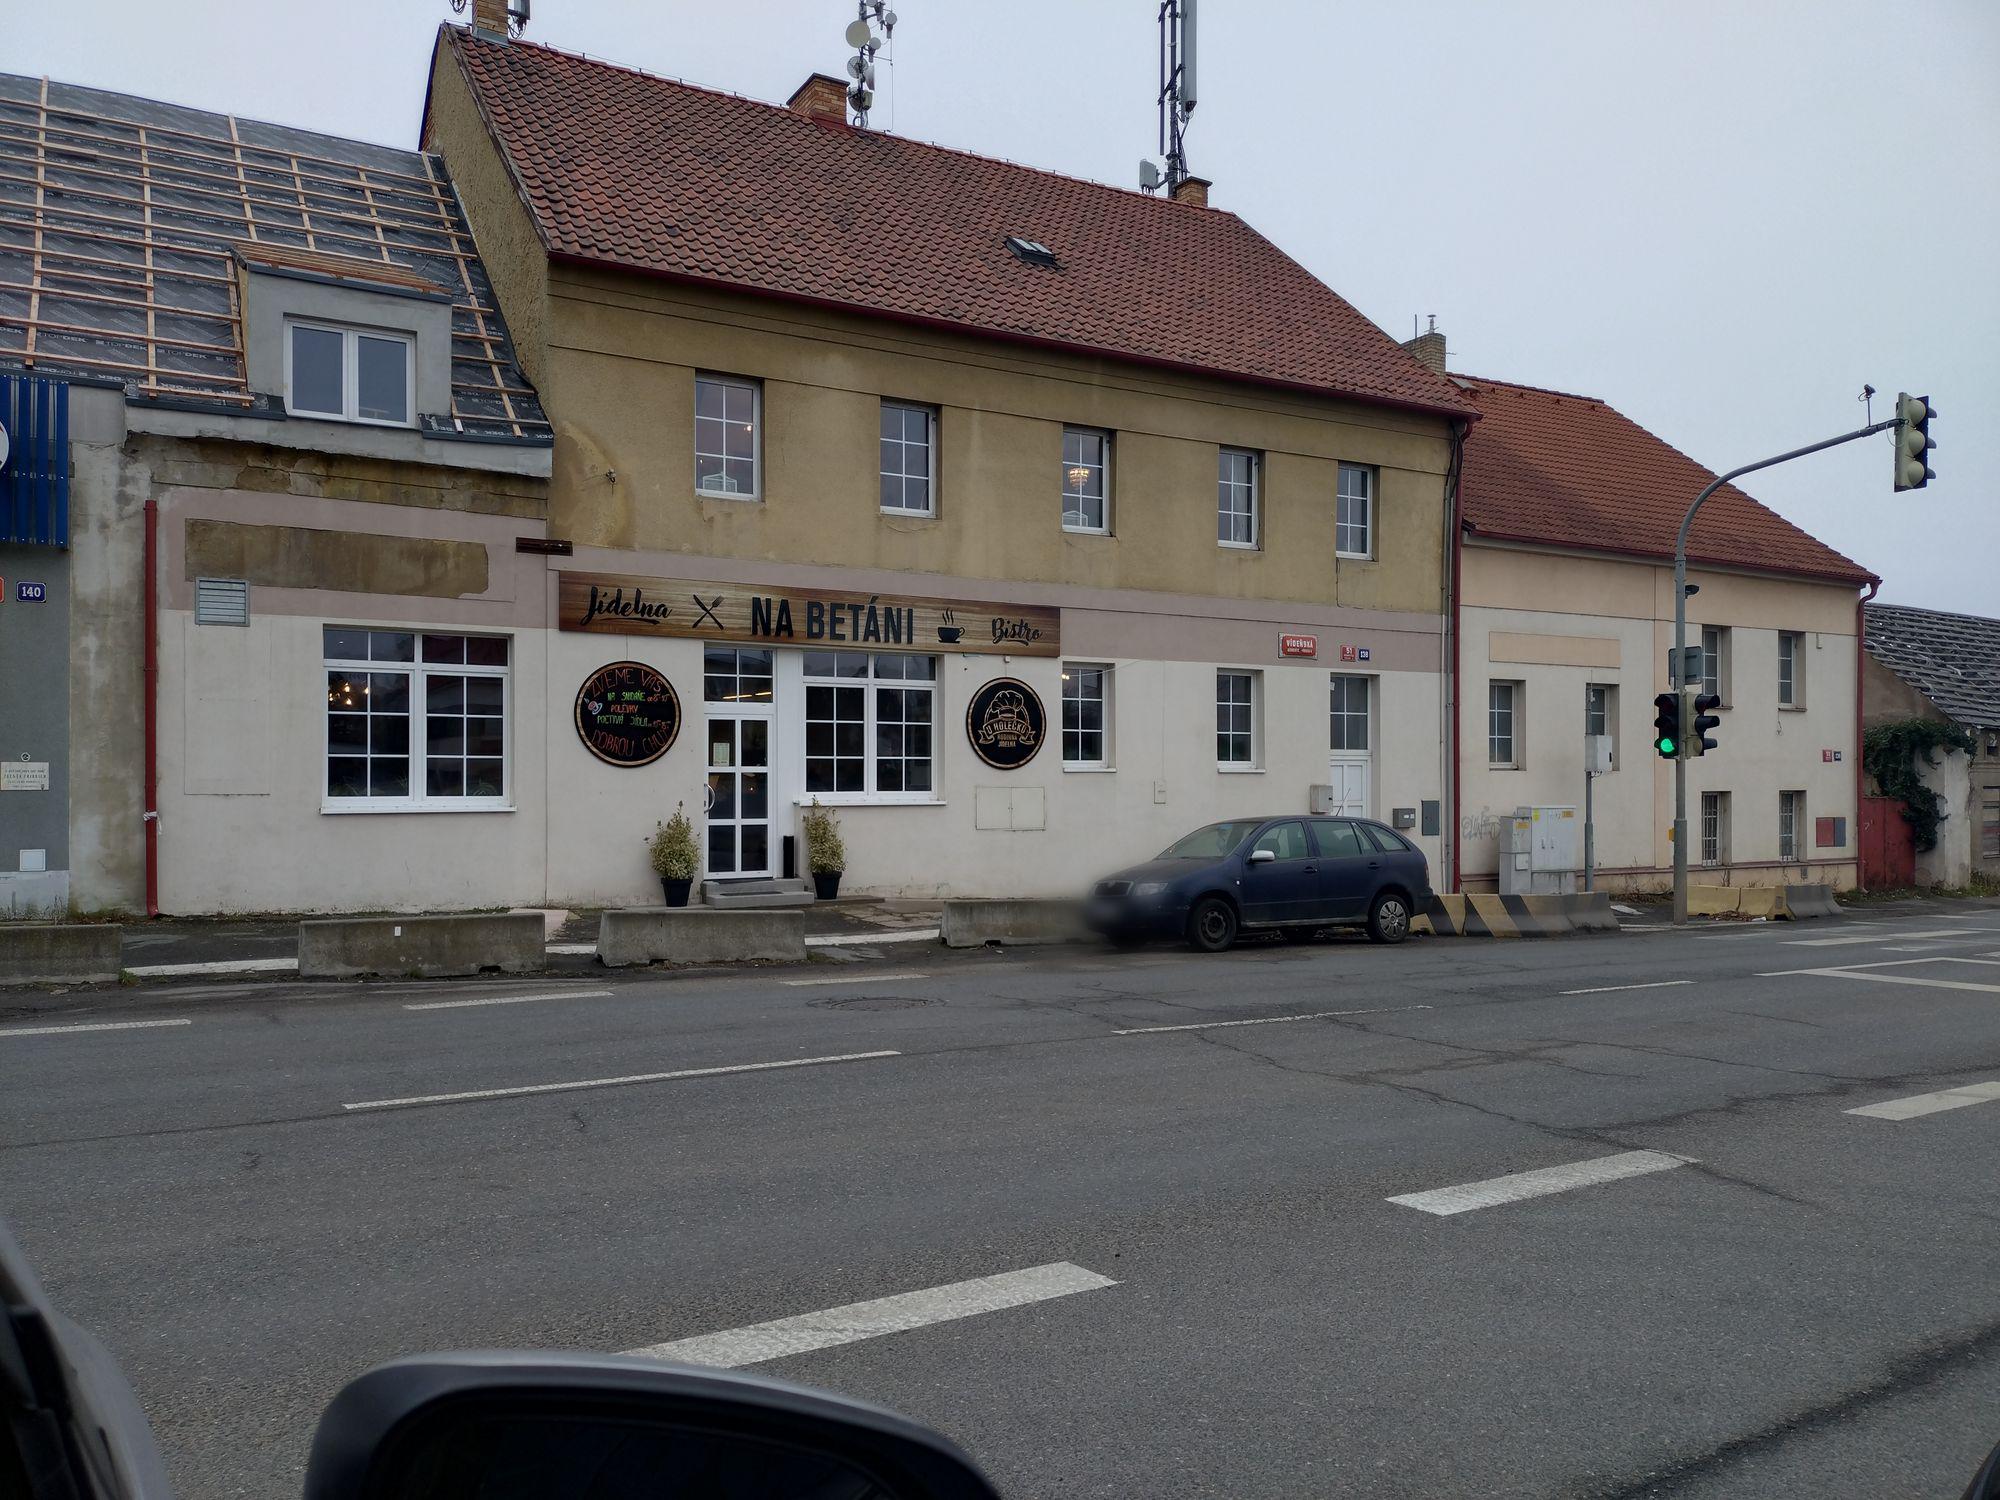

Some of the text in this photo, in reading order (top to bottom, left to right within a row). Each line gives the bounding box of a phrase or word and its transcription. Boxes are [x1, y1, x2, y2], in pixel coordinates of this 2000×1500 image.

[22, 586, 41, 598] 140
[579, 586, 673, 627] Jídelna
[751, 595, 914, 645] NA BETÁNI
[991, 617, 1043, 645] Bistro
[590, 668, 635, 697] ZVEME
[592, 729, 635, 756] DOBROU
[986, 725, 993, 734] U
